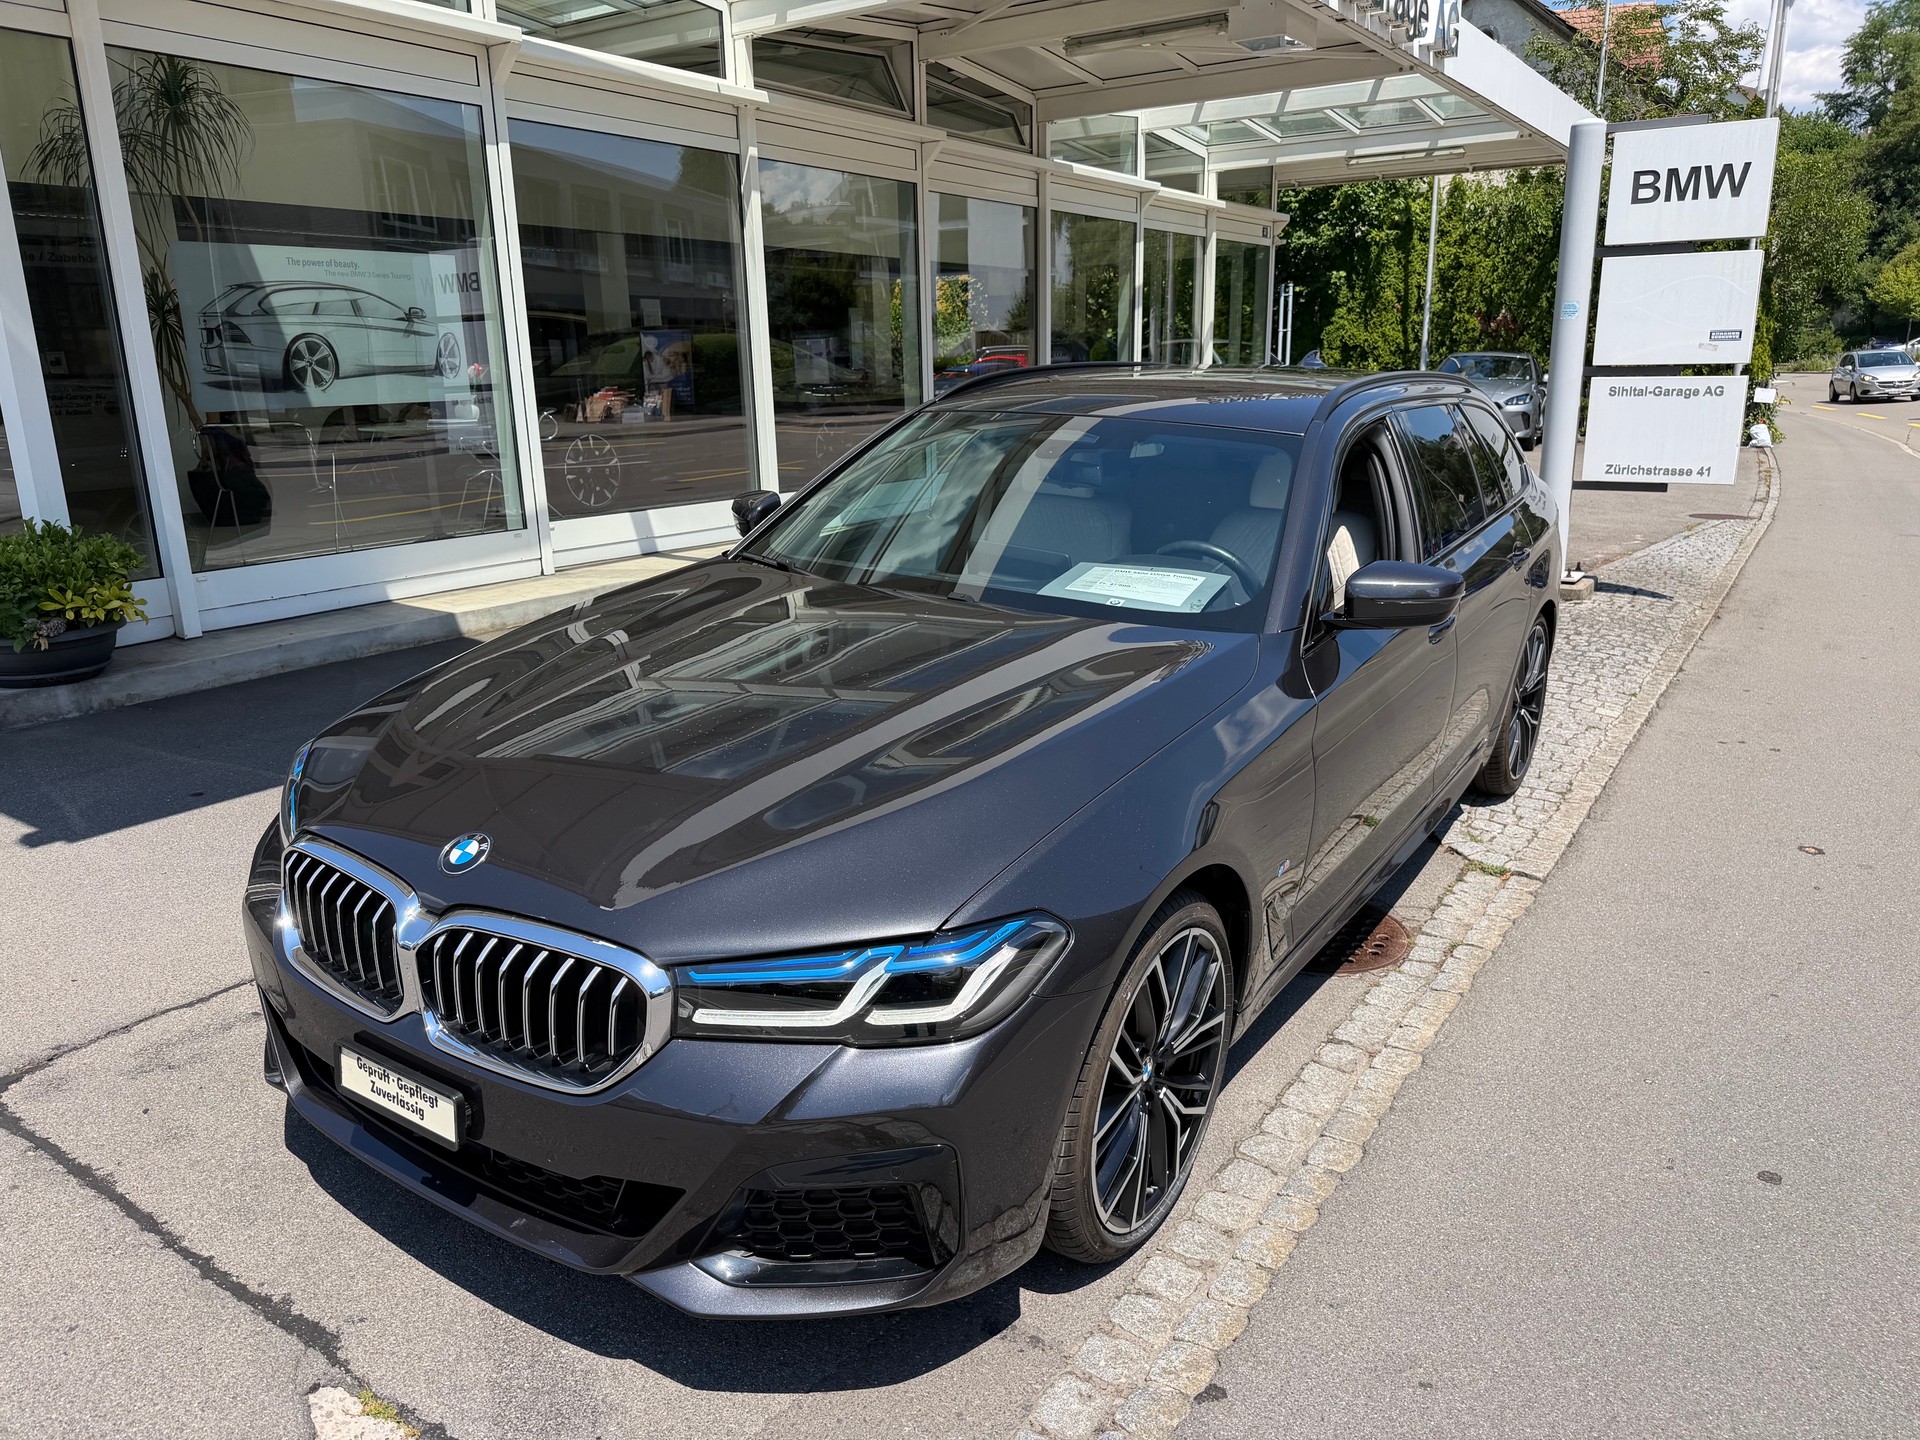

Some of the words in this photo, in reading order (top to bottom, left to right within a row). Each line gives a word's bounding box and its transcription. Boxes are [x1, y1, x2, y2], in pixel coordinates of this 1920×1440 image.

[1630, 161, 1752, 205] BMW
[285, 257, 300, 266] The
[302, 259, 324, 268] power
[325, 259, 333, 267] of
[333, 259, 360, 270] beauty.
[372, 271, 389, 279] Series
[1608, 385, 1700, 399] Sihltal-Garage
[1703, 385, 1725, 397] AG
[1604, 464, 1693, 477] Zürichstrasse
[1696, 466, 1712, 477] 41
[356, 1057, 390, 1084] Geprüft
[396, 1077, 439, 1109] Gepflegt
[370, 1080, 425, 1121] Zuverlässig
